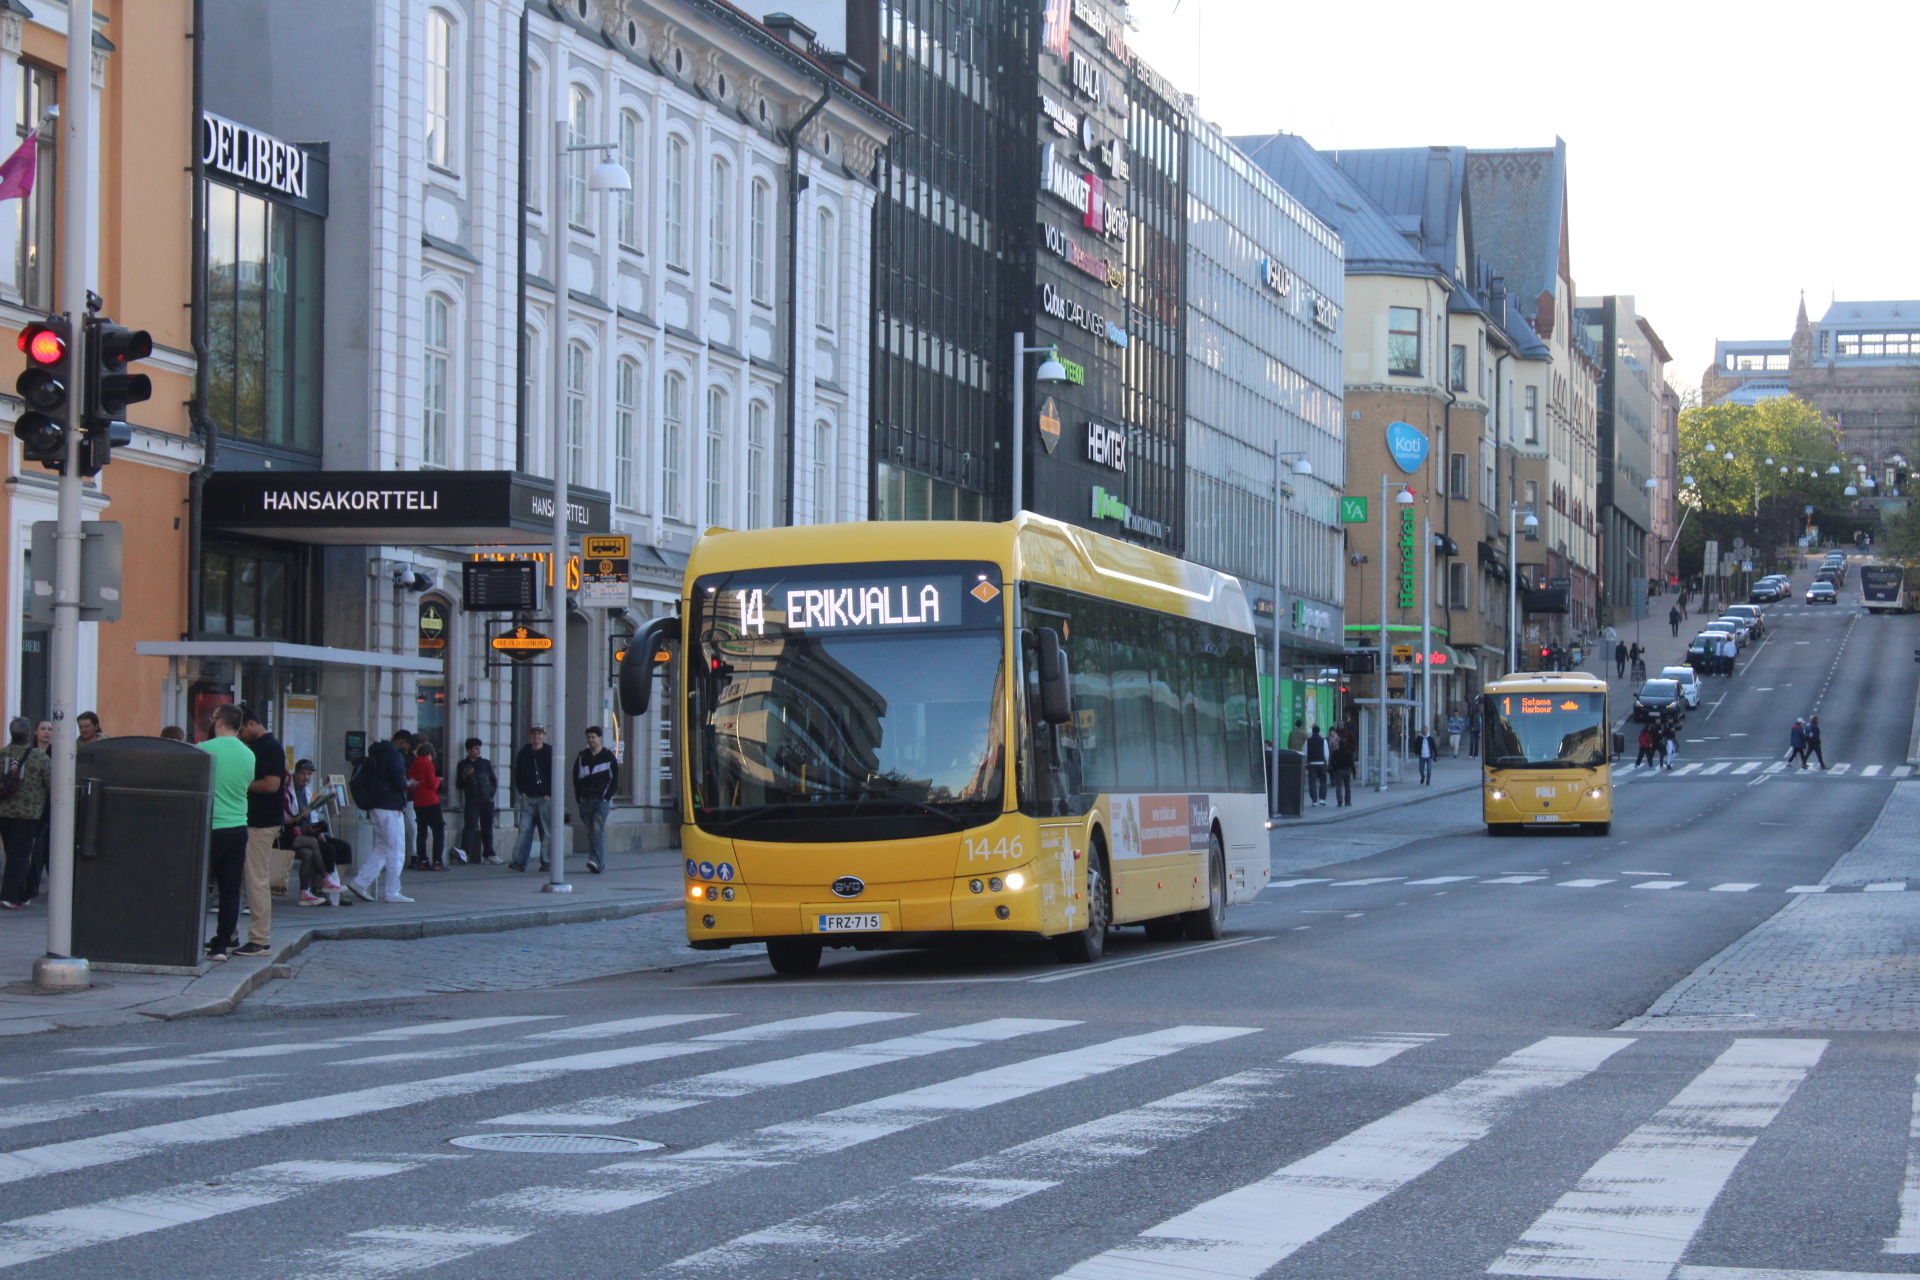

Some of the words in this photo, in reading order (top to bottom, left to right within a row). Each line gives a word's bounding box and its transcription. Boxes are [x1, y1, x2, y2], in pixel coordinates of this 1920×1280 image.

[1054, 161, 1091, 214] MARKET
[1045, 222, 1065, 257] VOLT
[1044, 282, 1065, 320] Cubus
[1066, 299, 1104, 338] CARLINGS
[1088, 421, 1127, 473] HEMTEX
[1395, 436, 1421, 452] Koti
[1395, 451, 1421, 460] Hammas
[263, 490, 438, 510] HANSAKORTTELI
[532, 496, 589, 525] HANSARTTELI
[602, 562, 611, 570] D3
[1399, 507, 1415, 608] Heineken
[736, 588, 765, 636] 14
[787, 584, 940, 629] ERIKVALLA
[1503, 697, 1511, 715] 1
[1521, 697, 1552, 706] Satama
[1521, 706, 1552, 714] Harbour
[1535, 786, 1556, 798] FÖLI
[1567, 783, 1579, 792] 11
[963, 834, 1023, 862] 1446
[833, 882, 862, 893] BYD
[828, 916, 878, 929] FRZ-715
